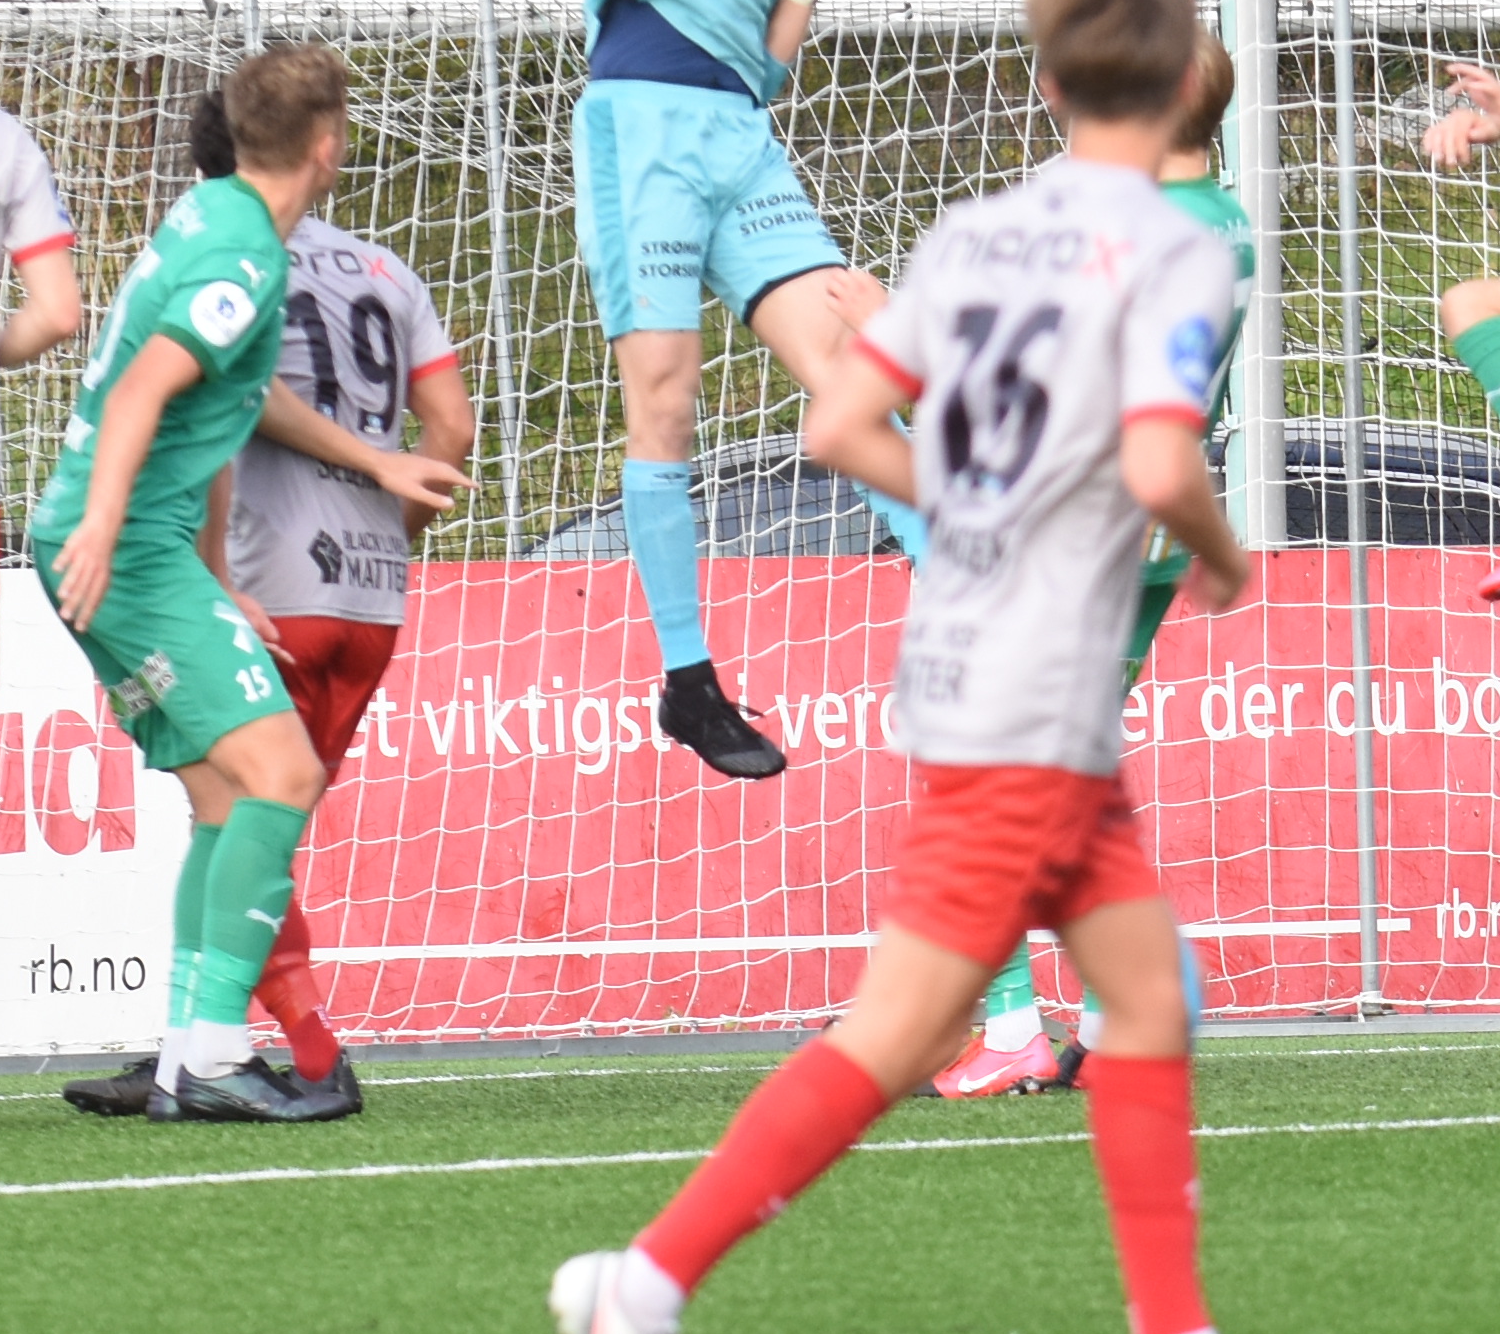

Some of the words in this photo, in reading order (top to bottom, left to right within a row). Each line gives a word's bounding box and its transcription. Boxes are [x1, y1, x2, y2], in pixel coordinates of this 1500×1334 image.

[285, 290, 398, 434] 19
[942, 301, 1063, 493] 16
[235, 665, 273, 703] 15
[1200, 661, 1304, 739] der
[30, 943, 146, 994] rb.no
